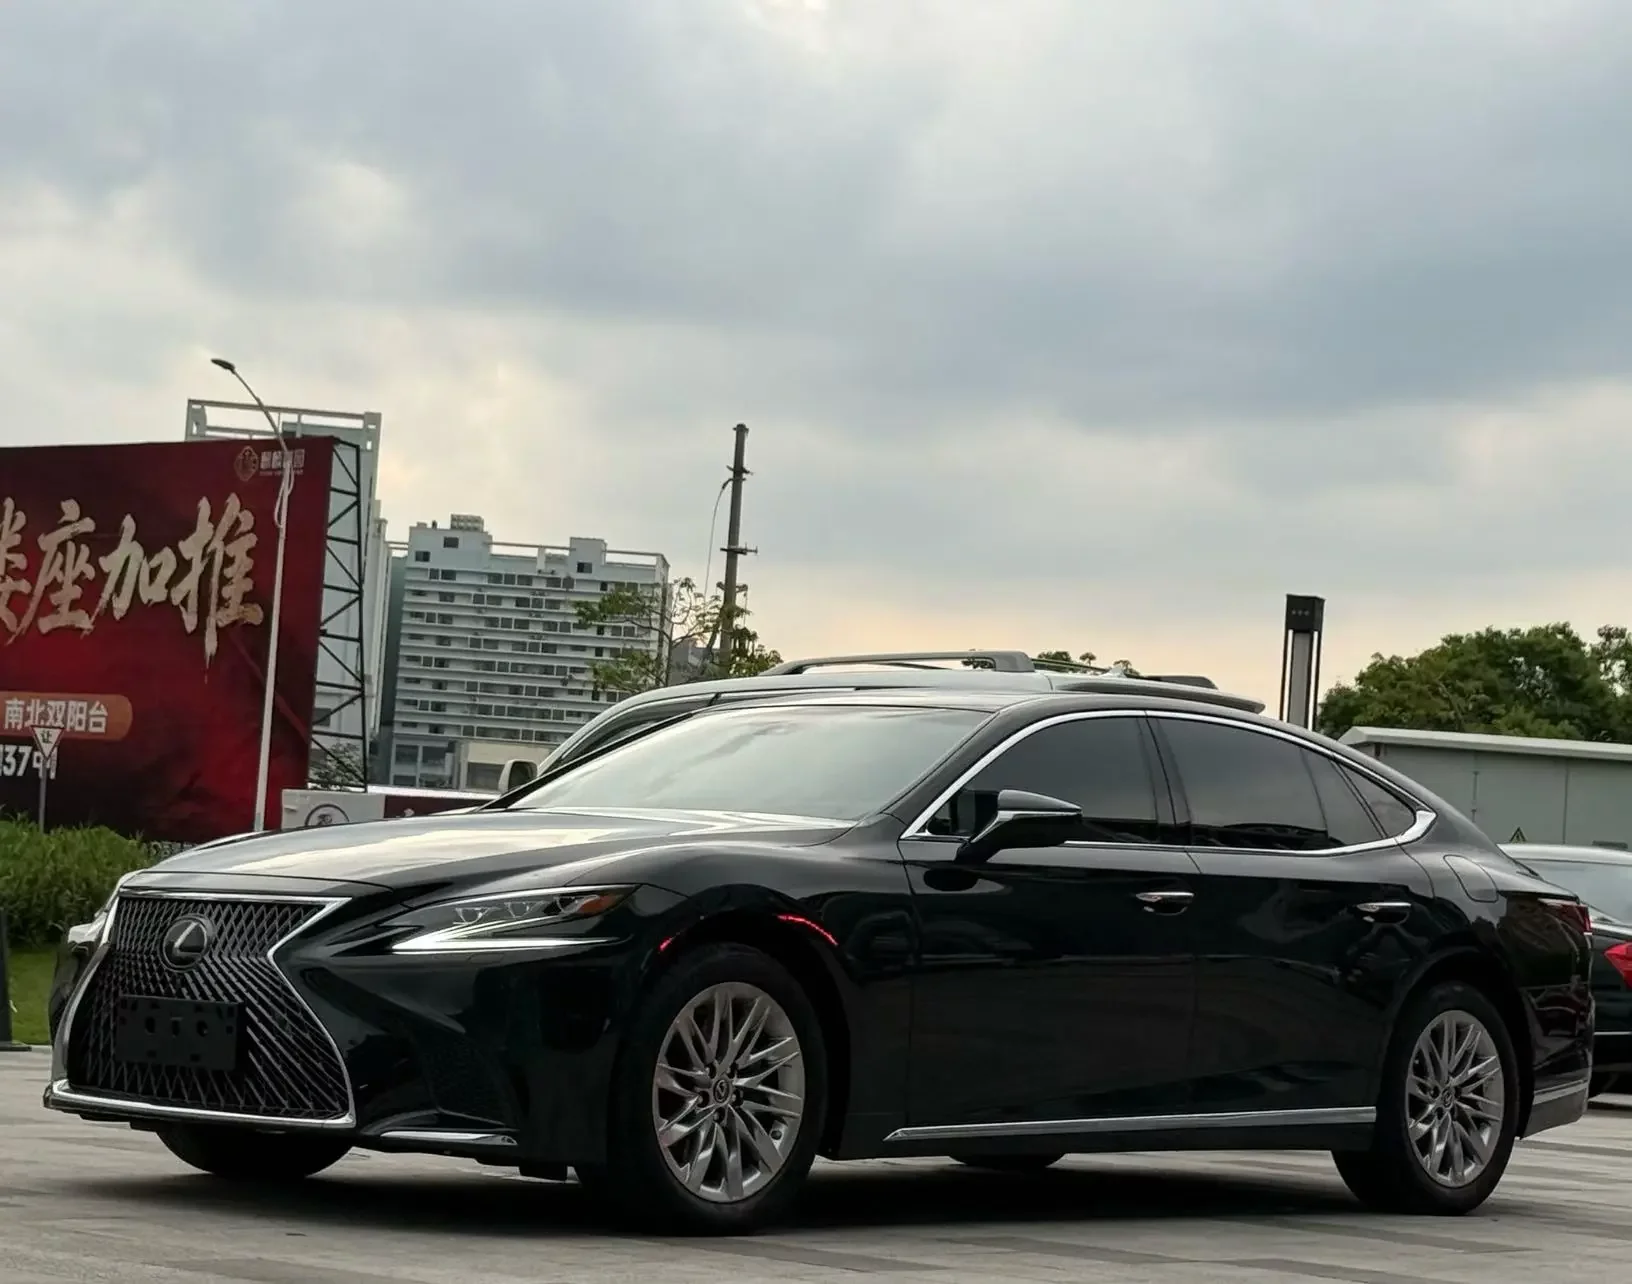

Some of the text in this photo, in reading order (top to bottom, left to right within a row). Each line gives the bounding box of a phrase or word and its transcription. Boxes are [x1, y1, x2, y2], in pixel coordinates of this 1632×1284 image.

[4, 697, 109, 733] 南北双阳台
